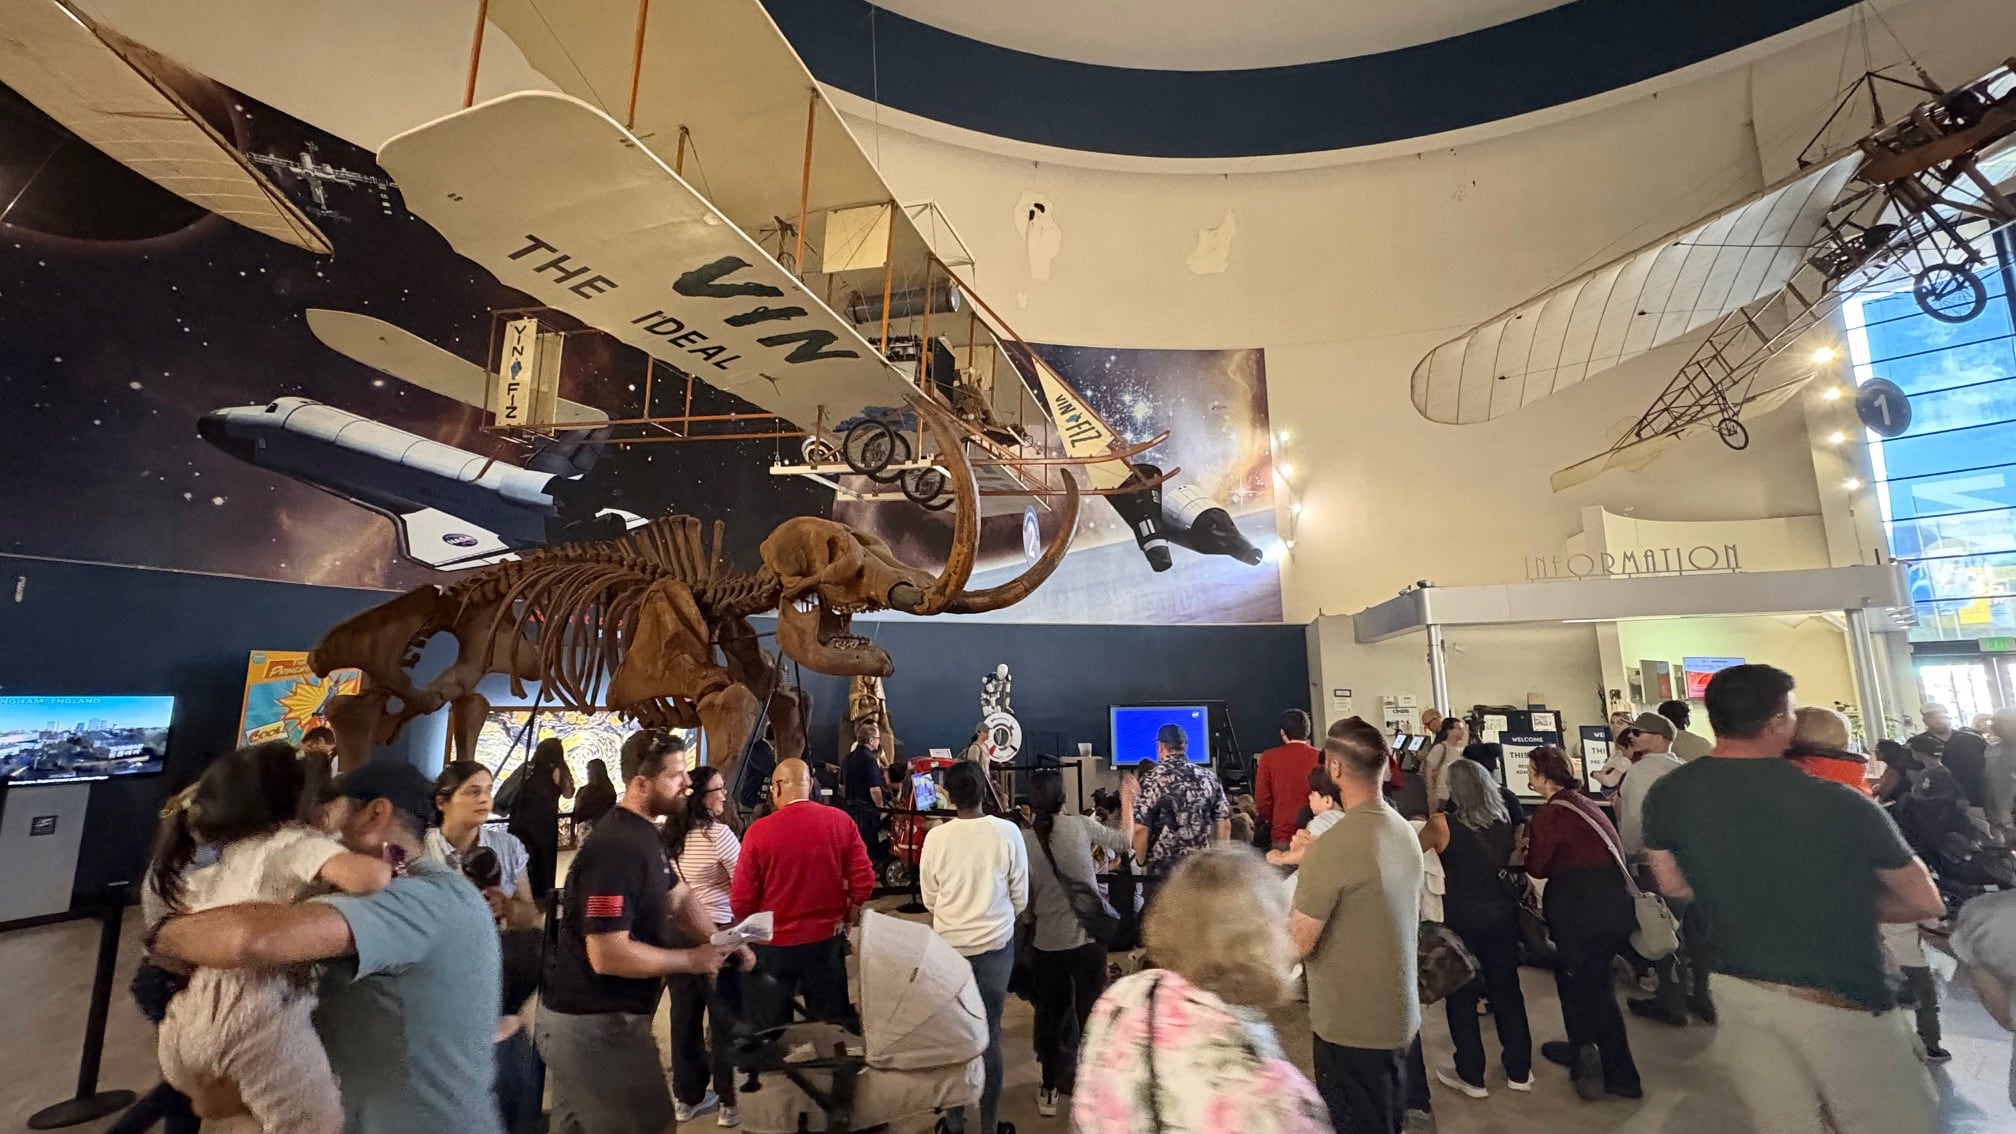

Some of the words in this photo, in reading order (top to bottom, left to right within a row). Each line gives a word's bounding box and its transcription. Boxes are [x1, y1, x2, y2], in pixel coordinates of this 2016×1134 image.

[508, 234, 619, 299] THE
[672, 256, 861, 364] VIN
[630, 310, 742, 370] IDEAL
[505, 383, 520, 419] FIZ
[1055, 394, 1077, 416] VIN
[1873, 393, 1892, 426] 1
[1065, 420, 1103, 449] FIZ
[1028, 520, 1036, 559] 2
[1523, 544, 1741, 580] INFORMATION
